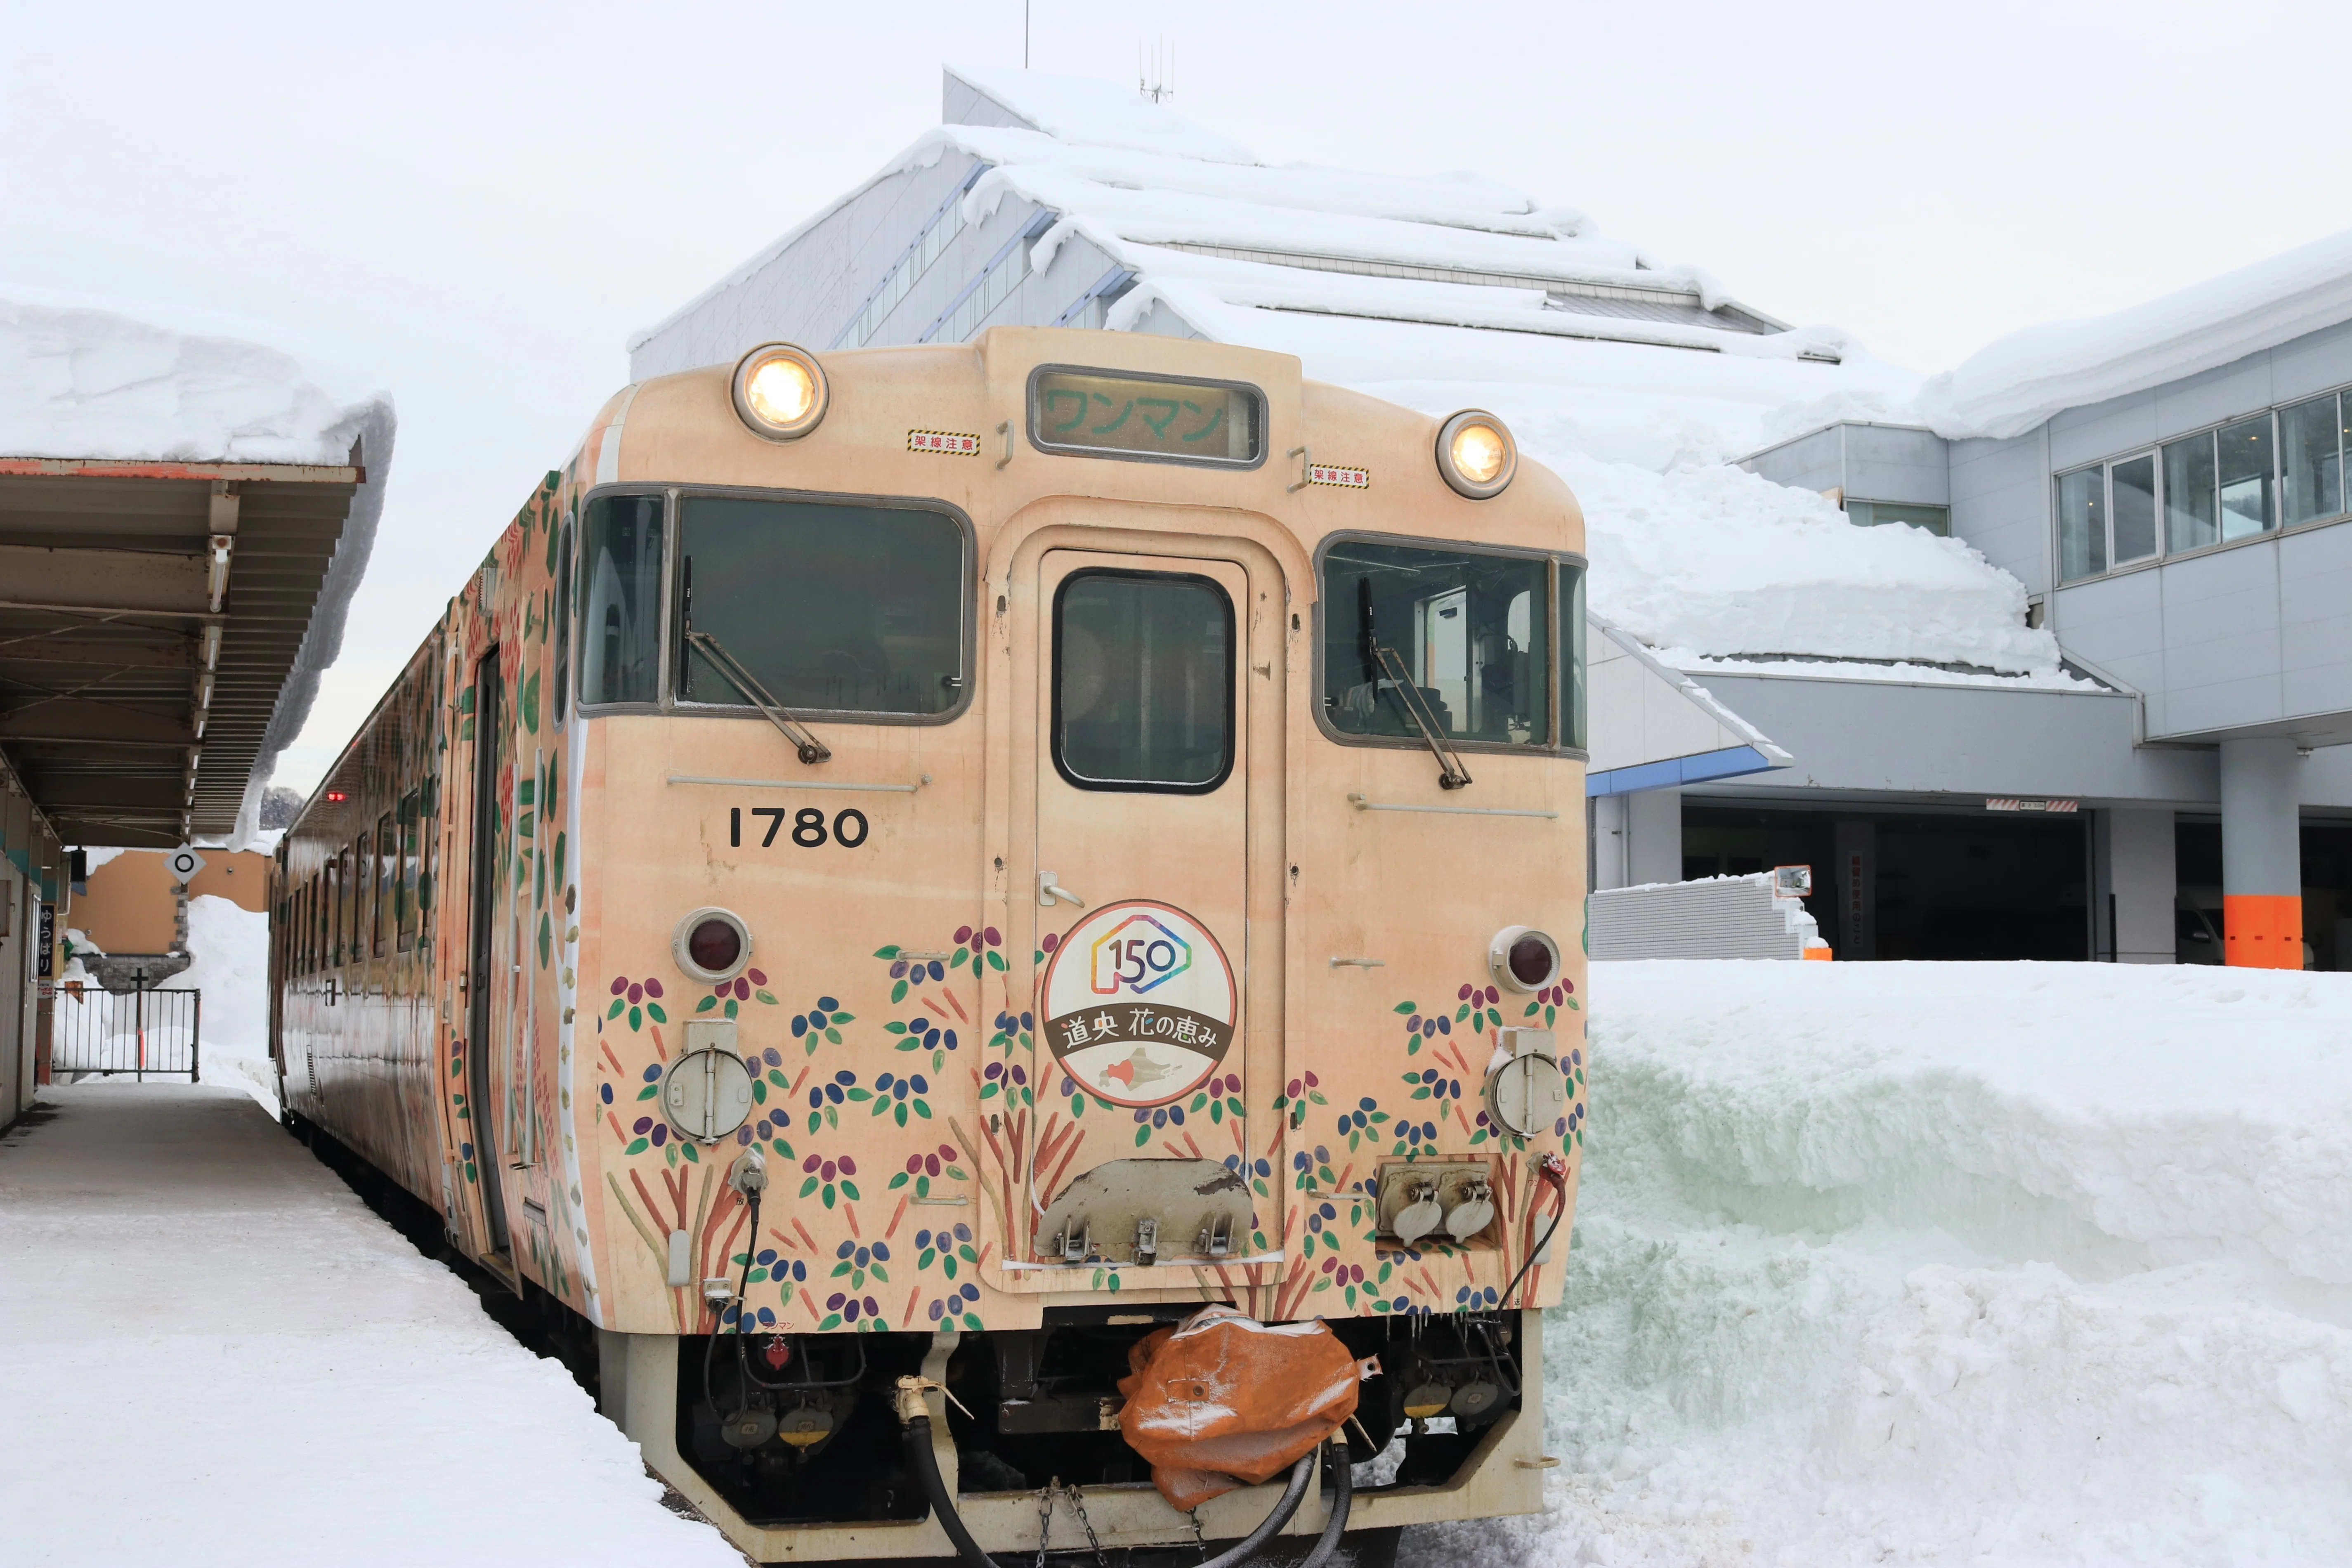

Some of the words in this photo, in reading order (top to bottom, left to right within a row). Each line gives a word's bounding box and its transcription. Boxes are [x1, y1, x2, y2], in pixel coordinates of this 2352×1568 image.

[1047, 389, 1223, 442] ワンマン
[914, 435, 973, 451] 架線注意
[1314, 469, 1363, 484] 架線注意
[730, 807, 869, 848] 1780
[40, 909, 52, 972] ゆうばり
[1108, 939, 1176, 983] 150
[1061, 1011, 1119, 1049] 道央
[1128, 1008, 1217, 1047] 花の恵み
